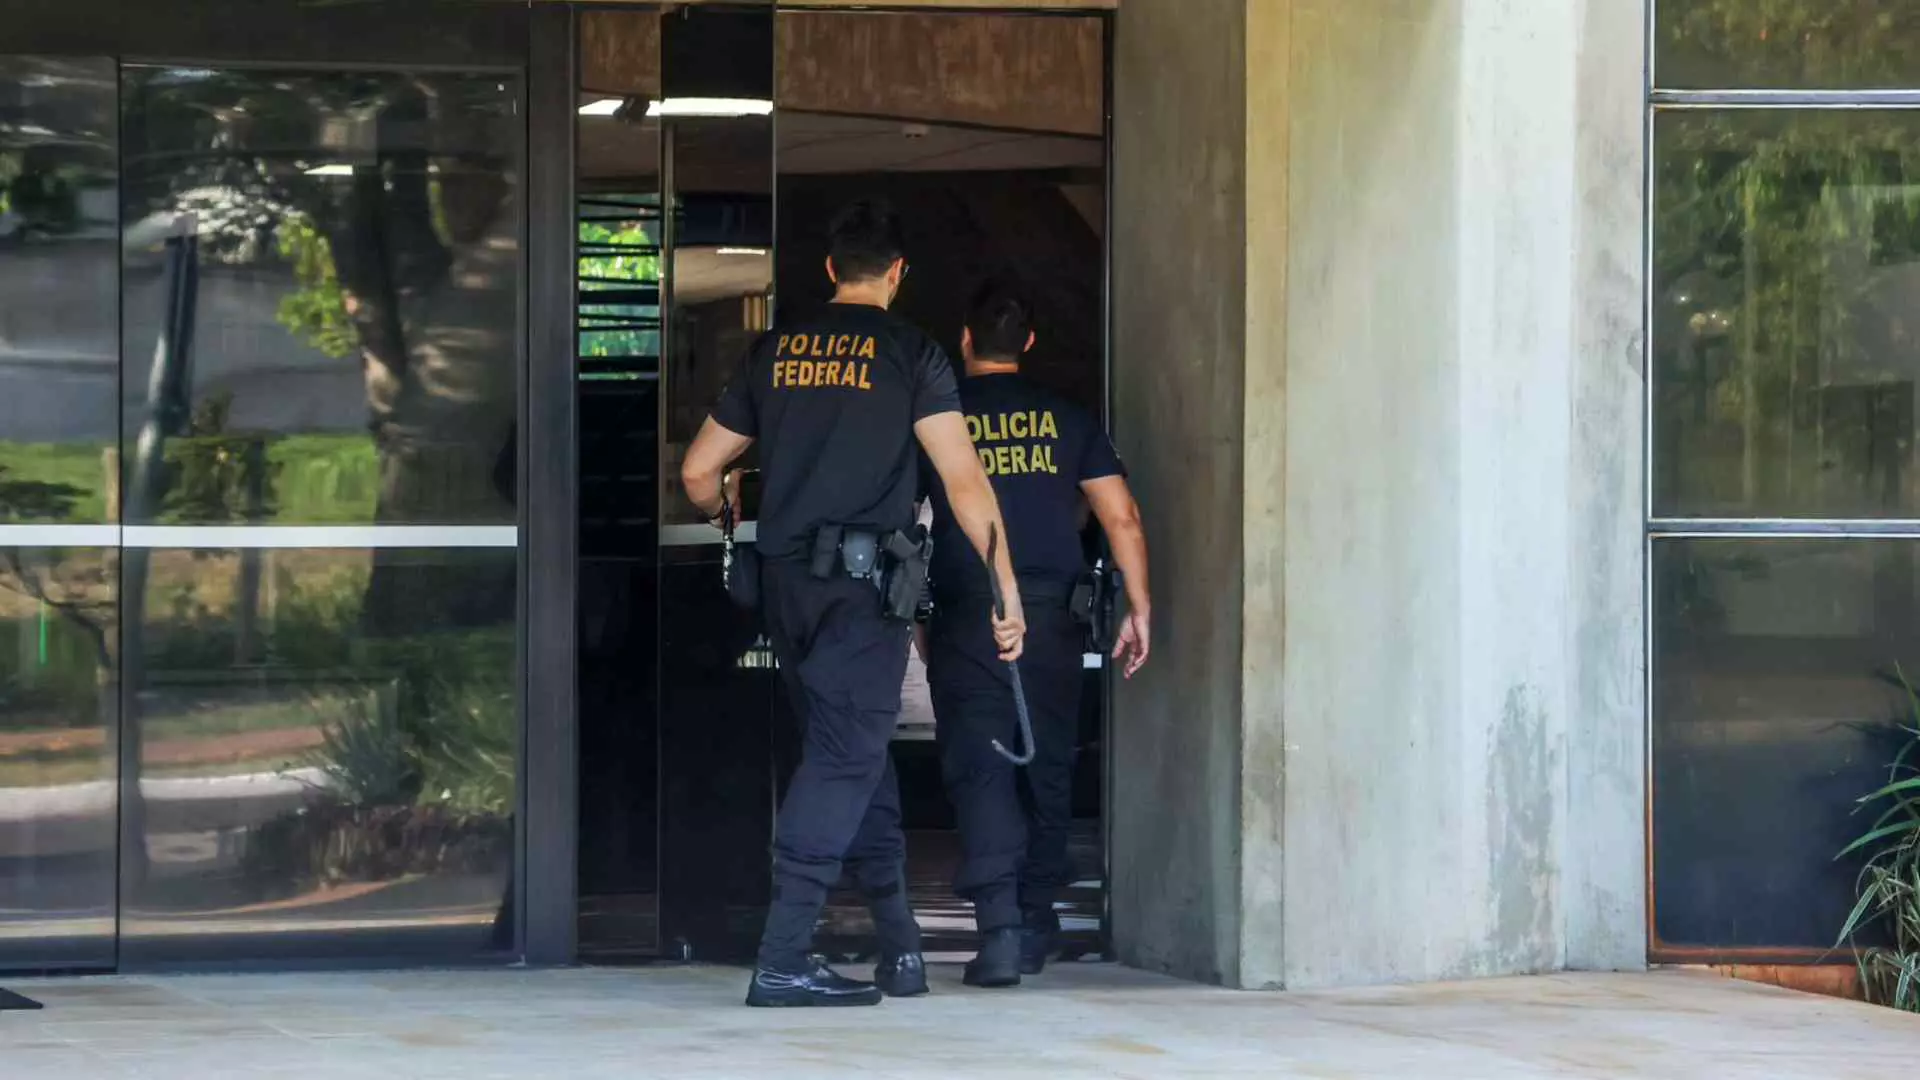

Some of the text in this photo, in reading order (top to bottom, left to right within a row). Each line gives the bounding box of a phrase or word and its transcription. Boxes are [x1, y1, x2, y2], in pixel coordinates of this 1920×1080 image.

[776, 334, 876, 359] POLICIA
[773, 360, 872, 389] FEDERAL
[965, 411, 1058, 442] OLICIA
[978, 445, 1058, 476] DERAL
